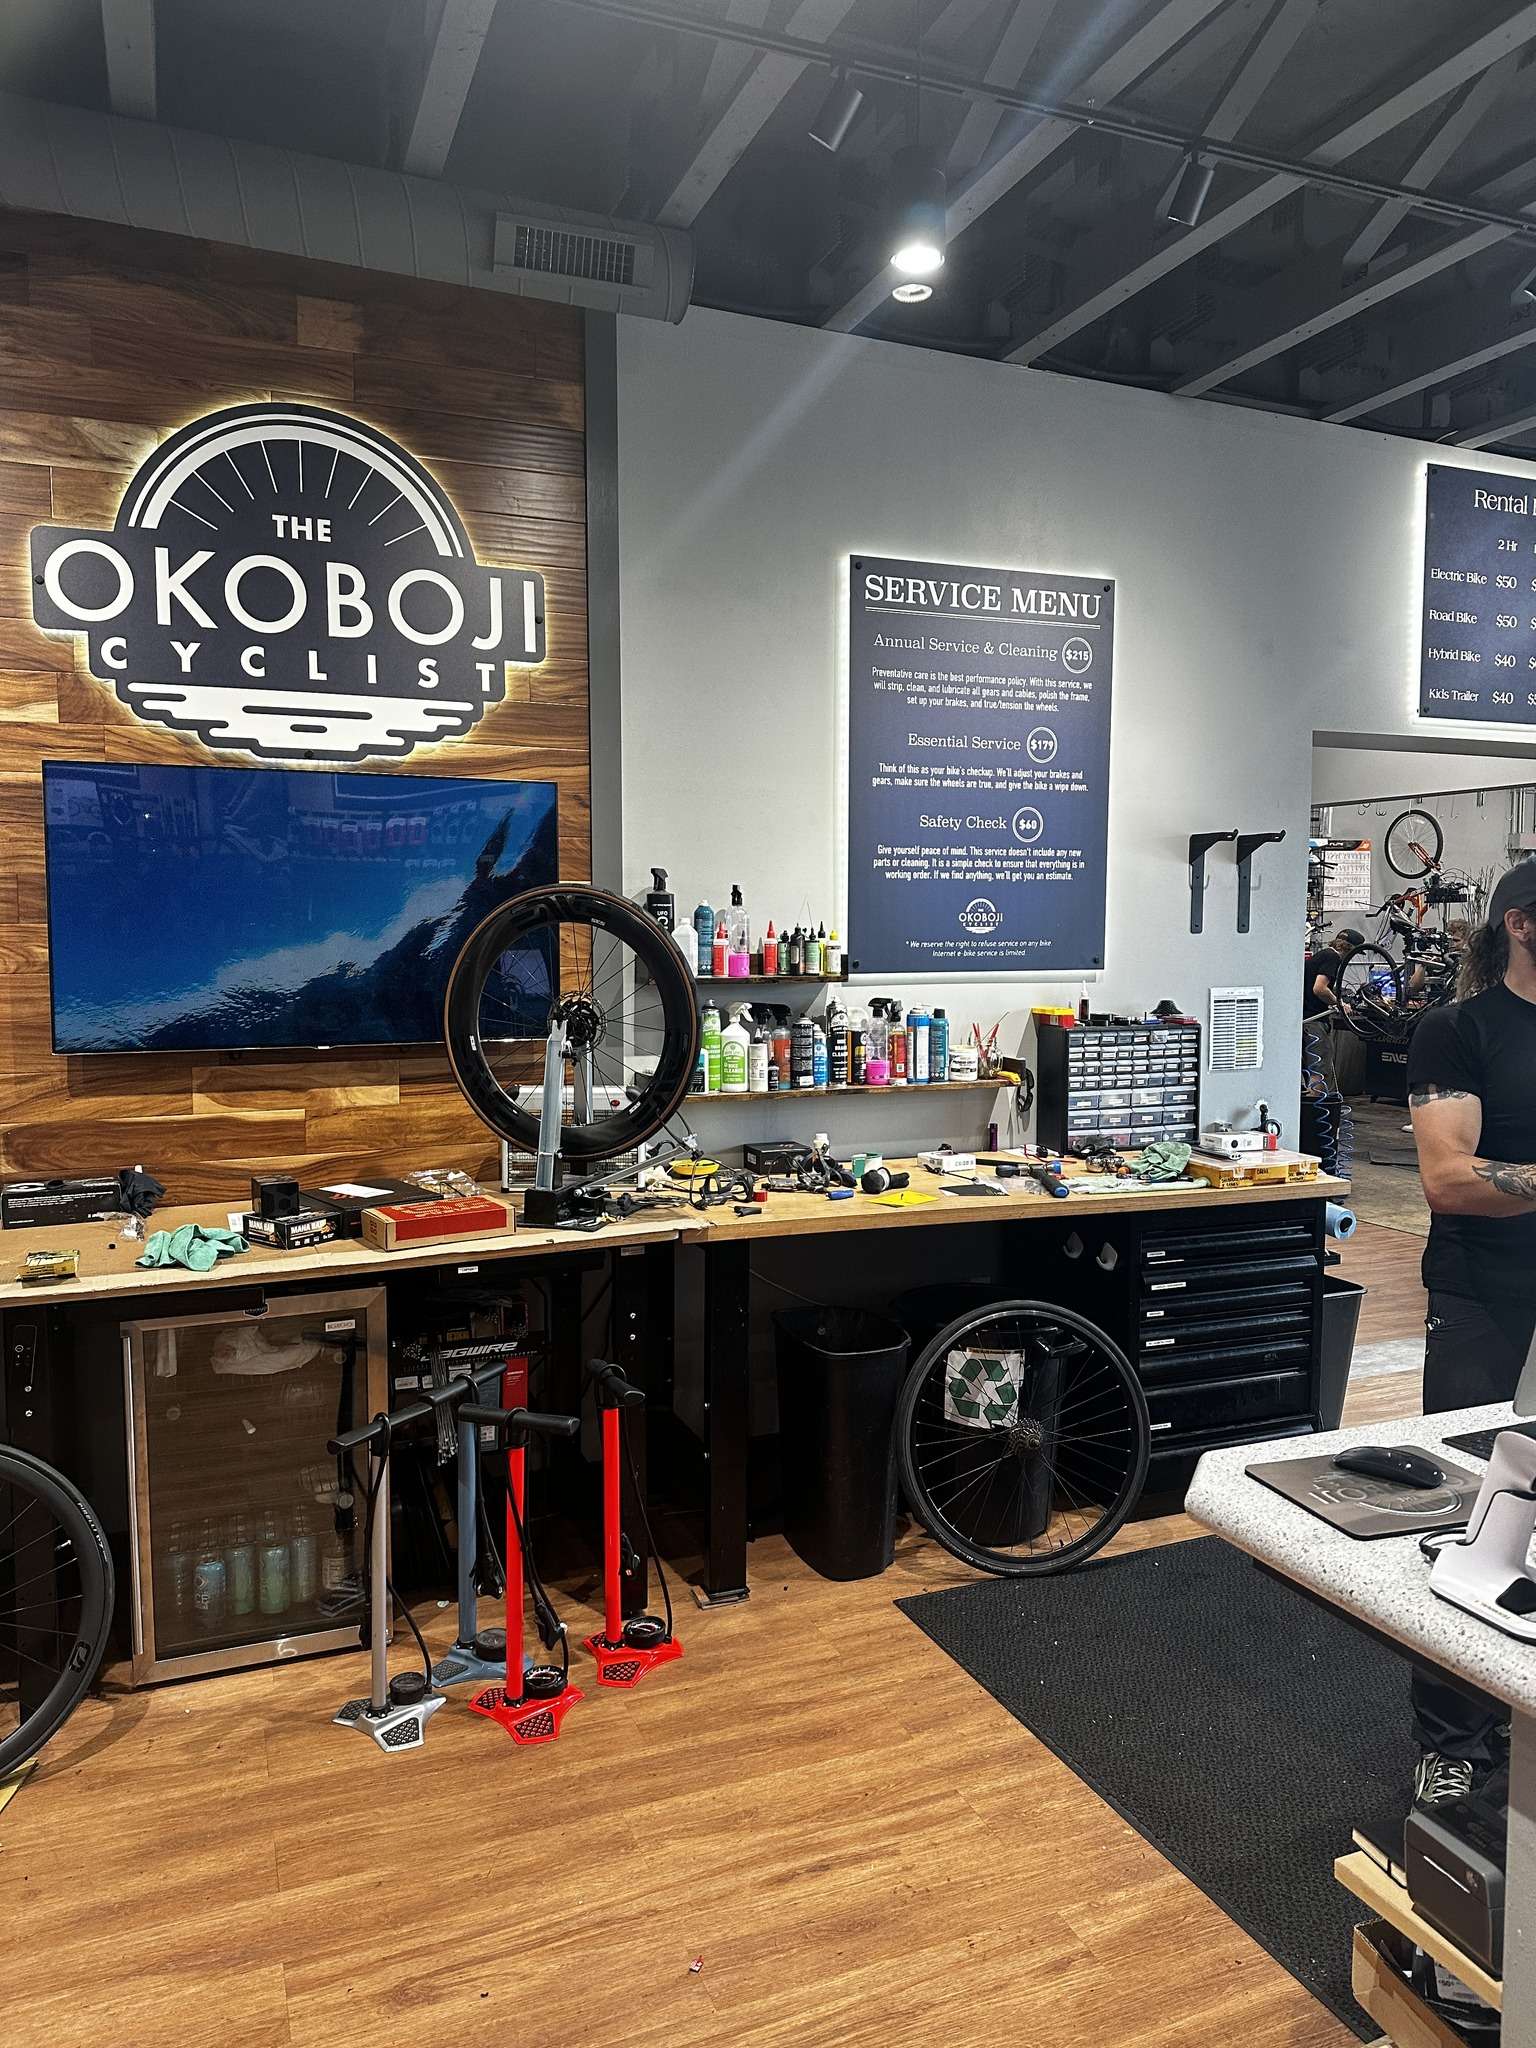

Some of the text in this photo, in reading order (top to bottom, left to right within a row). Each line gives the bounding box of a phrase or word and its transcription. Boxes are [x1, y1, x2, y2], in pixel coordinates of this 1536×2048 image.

[1474, 489, 1528, 515] Rental
[272, 514, 332, 543] THE
[1498, 540, 1517, 551] 2 Hr
[1431, 568, 1464, 582] Electric
[1467, 572, 1488, 584] Bike
[1496, 575, 1517, 589] $50
[44, 539, 536, 652] OKOBOJI
[864, 574, 1101, 618] SERVICE MENU
[1429, 609, 1454, 622] Road
[1457, 612, 1477, 624] Bike
[1496, 614, 1517, 629] $50
[874, 634, 1090, 661] Annual Service & Cleaning $215
[100, 636, 496, 692] CYCLIST
[1428, 648, 1459, 662] Hybrid
[1461, 651, 1481, 663] Bike
[1494, 654, 1516, 668] $40
[872, 667, 912, 678] Preventative
[930, 670, 936, 680] is
[937, 671, 948, 680] the
[949, 672, 963, 681] best
[965, 672, 1006, 686] performance
[1007, 675, 1028, 687] policy.
[1029, 676, 1043, 686] With
[1044, 677, 1056, 687] this
[1057, 678, 1082, 690] service,
[873, 681, 885, 690] will
[928, 683, 940, 693] and
[941, 684, 970, 694] lubricate
[971, 686, 980, 695] all
[981, 688, 1000, 698] gears
[1001, 687, 1013, 697] and
[1038, 689, 1057, 701] polish
[1058, 690, 1069, 700] the
[1429, 688, 1449, 700] Kids
[1451, 690, 1479, 702] Trailer
[1492, 691, 1514, 705] $40
[906, 696, 917, 704] set
[918, 699, 927, 707] up
[928, 699, 943, 708] your
[970, 699, 982, 707] and
[983, 700, 1022, 709] true/tension
[1023, 701, 1034, 710] the
[908, 734, 1054, 751] Essential Service $179
[879, 763, 896, 773] Think
[898, 764, 905, 773] of
[906, 764, 919, 773] this
[930, 767, 944, 776] your
[946, 766, 965, 775] bike's
[996, 767, 1012, 776] We'll
[1013, 768, 1032, 780] adjust
[1033, 771, 1047, 780] your
[1049, 769, 1070, 778] brakes
[1071, 770, 1082, 779] and
[894, 778, 912, 786] make
[929, 779, 940, 787] the
[941, 779, 964, 788] wheels
[994, 780, 1006, 789] and
[1008, 781, 1021, 791] give
[1022, 781, 1032, 789] the
[1034, 782, 1047, 790] bike
[1054, 782, 1068, 792] wipe
[919, 816, 1037, 830] Safety Check $60
[877, 845, 891, 854] Give
[893, 845, 919, 857] yourself
[920, 848, 940, 857] peace
[942, 846, 949, 855] of
[969, 846, 982, 855] This
[984, 847, 1006, 855] service
[1008, 847, 1031, 856] doesn't
[1032, 847, 1054, 856] include
[1056, 850, 1067, 858] any
[873, 858, 890, 869] parts
[931, 859, 936, 867] It
[938, 859, 944, 867] is
[951, 859, 972, 870] simple
[974, 859, 993, 868] check
[994, 860, 1001, 868] to
[1025, 860, 1037, 868] that
[1038, 860, 1070, 870] everything
[885, 870, 911, 881] working
[933, 870, 938, 879] If
[951, 871, 963, 879] find
[995, 871, 1010, 880] we'll
[1011, 871, 1022, 882] get
[1023, 874, 1034, 882] you
[959, 912, 1003, 922] OKOBOJI
